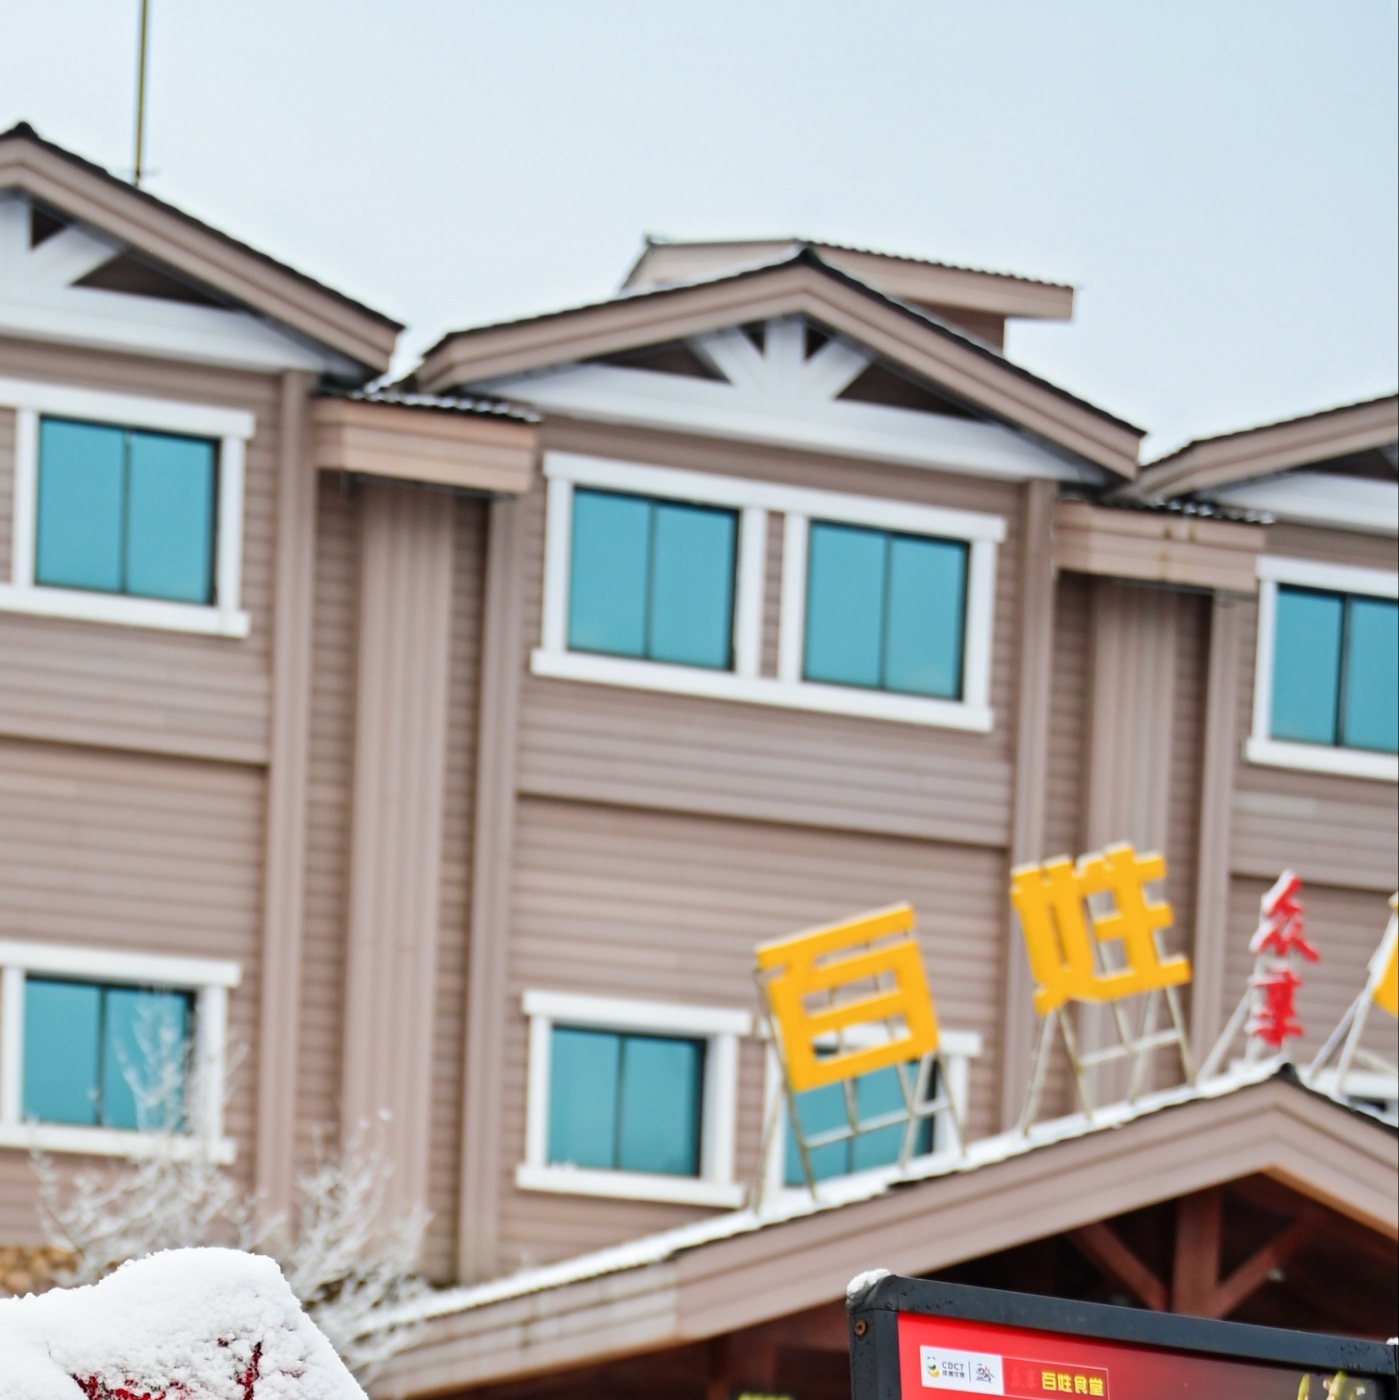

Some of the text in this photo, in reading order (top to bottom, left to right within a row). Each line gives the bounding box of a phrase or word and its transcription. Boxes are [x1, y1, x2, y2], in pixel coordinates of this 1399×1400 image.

[942, 1361, 965, 1371] CDCT
[1041, 1370, 1104, 1397] 百姓食堂
